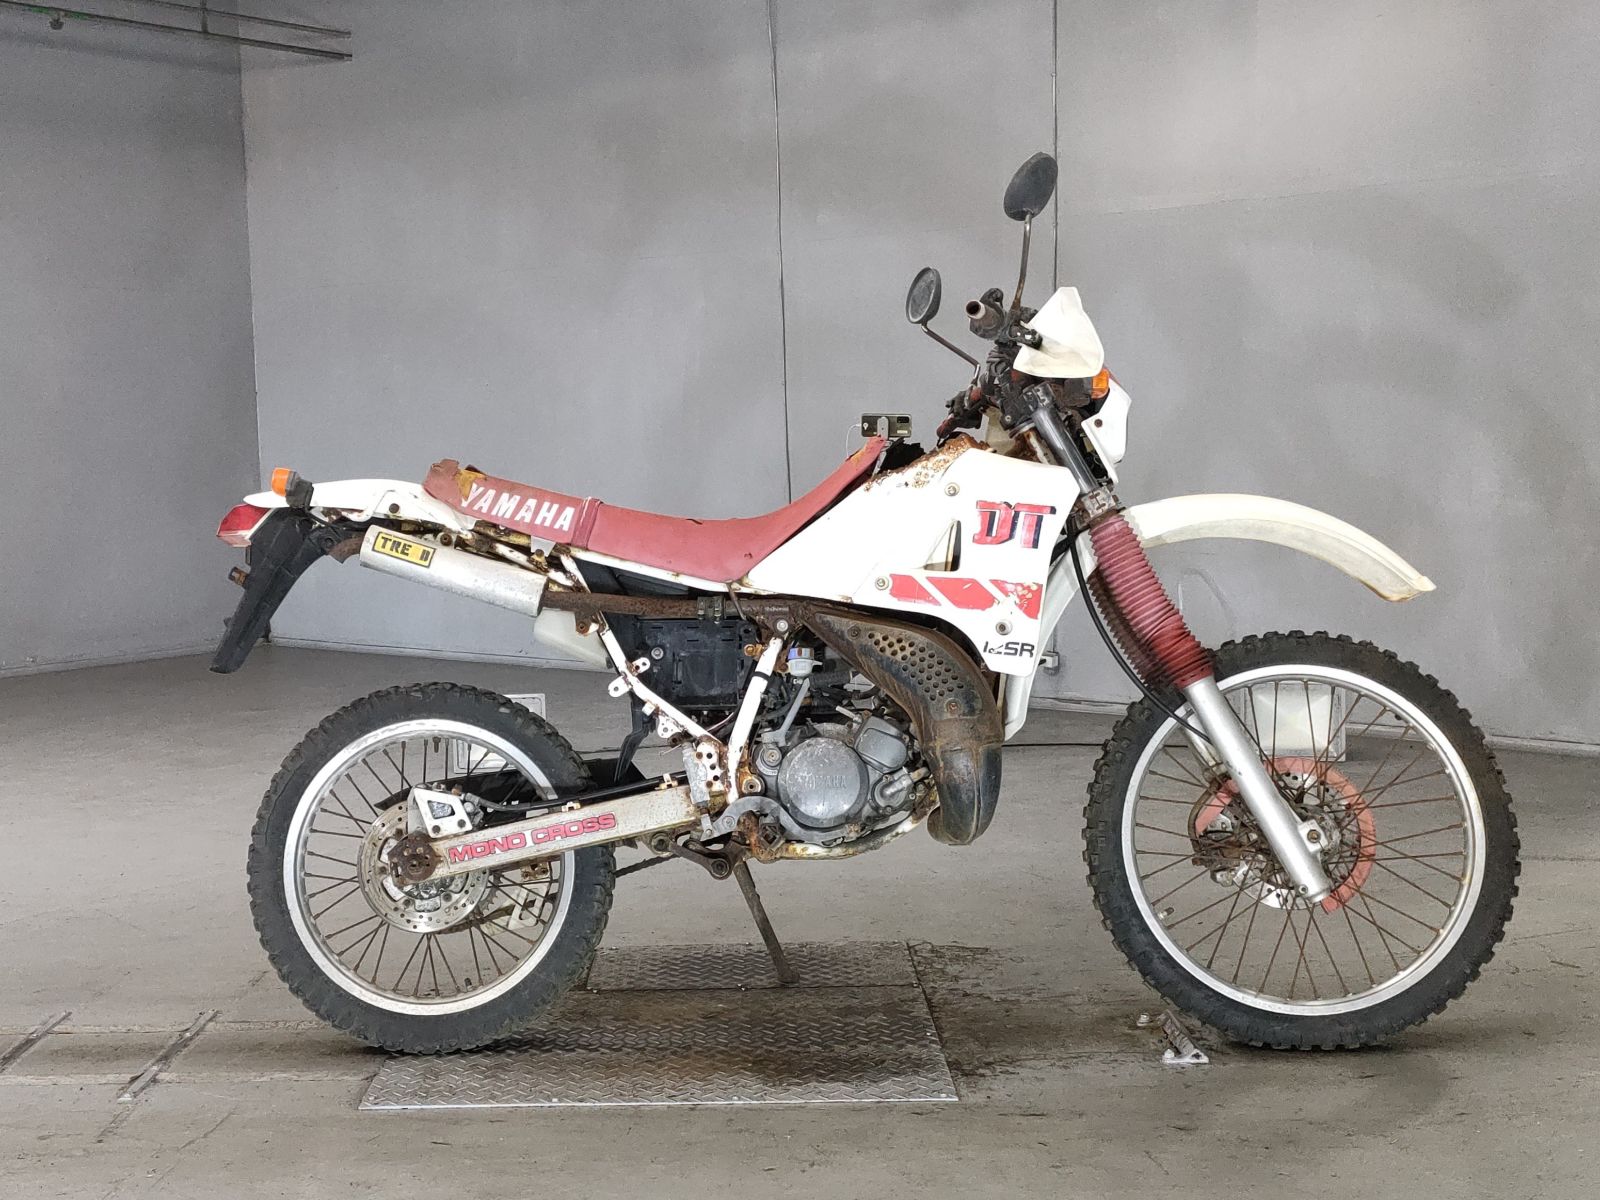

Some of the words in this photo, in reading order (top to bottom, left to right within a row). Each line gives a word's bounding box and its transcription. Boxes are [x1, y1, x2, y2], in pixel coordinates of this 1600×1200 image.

[461, 483, 575, 531] YAMAHA
[972, 500, 1056, 549] DT
[449, 832, 527, 863] MONO
[531, 813, 616, 844] CROSS
